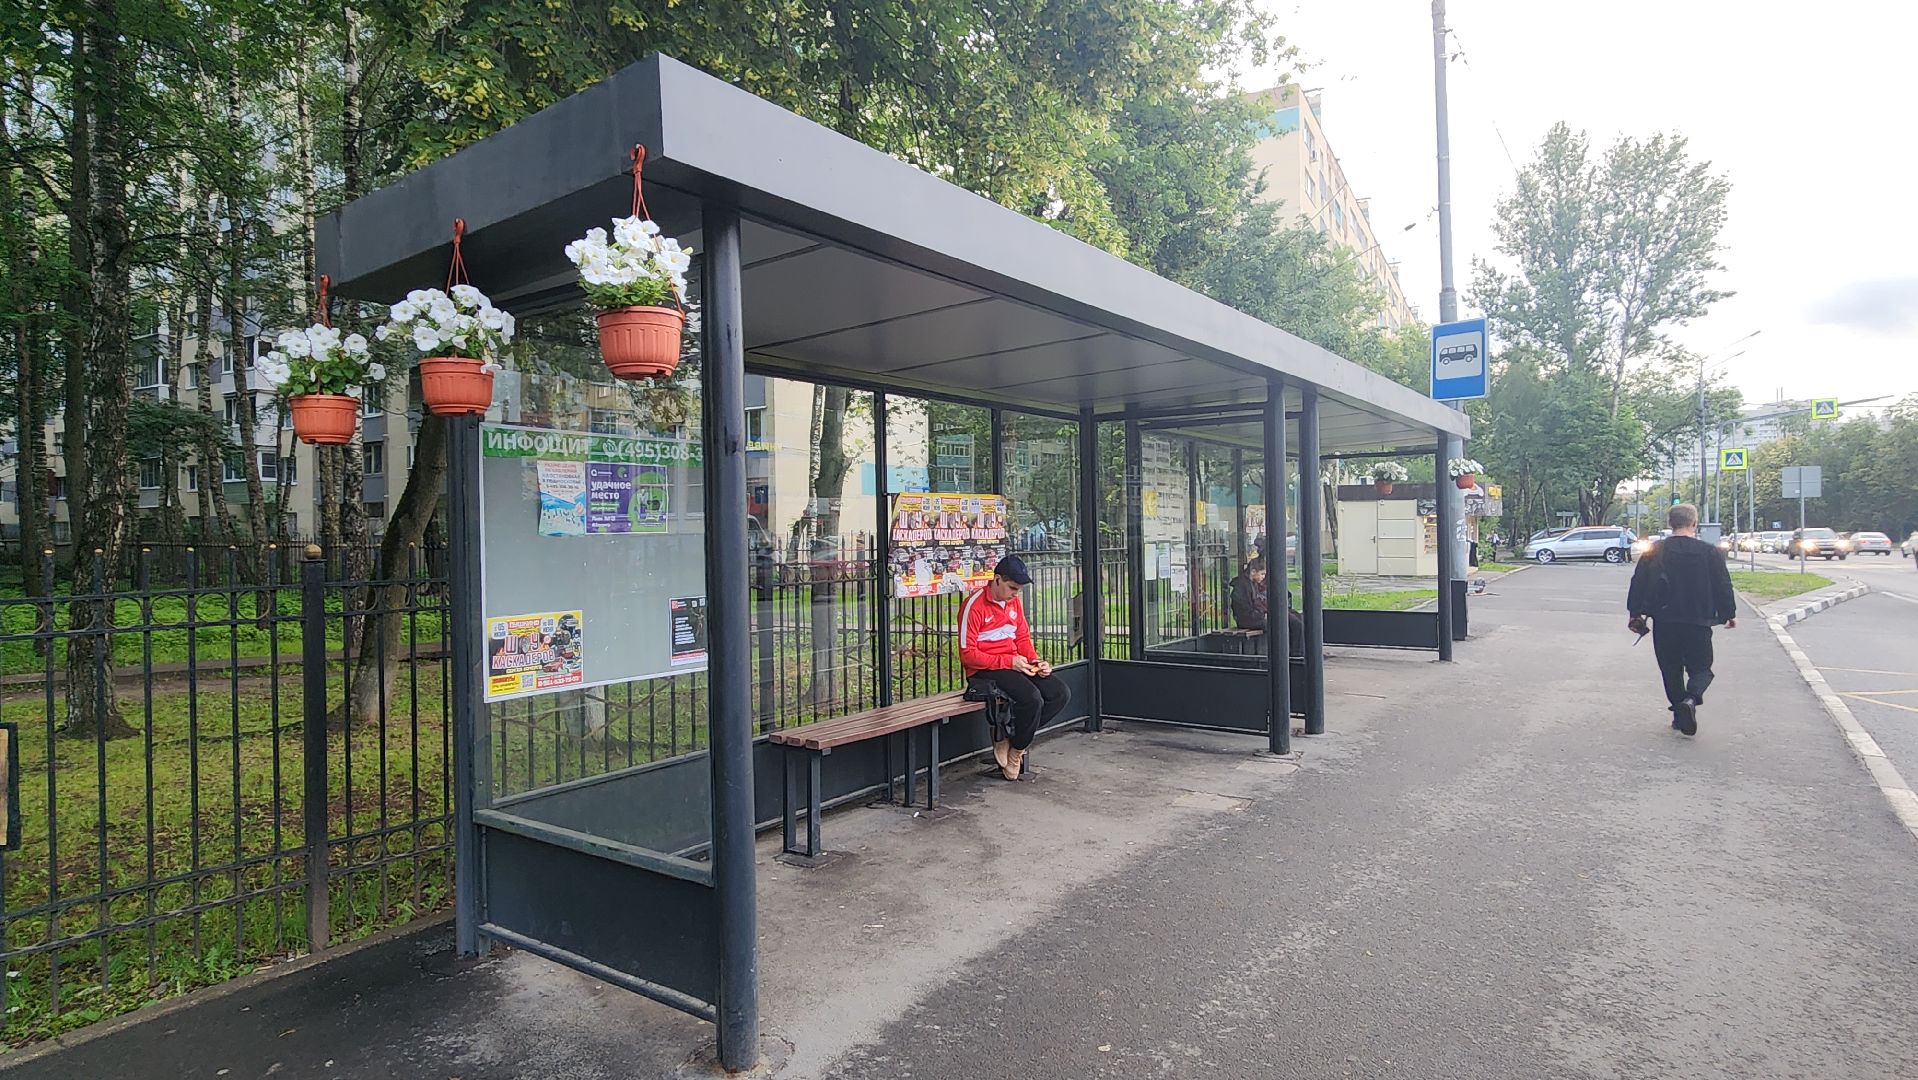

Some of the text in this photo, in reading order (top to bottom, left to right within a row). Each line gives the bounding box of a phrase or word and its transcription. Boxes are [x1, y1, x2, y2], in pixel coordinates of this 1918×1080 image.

[488, 432, 591, 456] ИНФОЩИТ
[591, 481, 632, 491] удачное
[591, 492, 620, 500] место
[492, 648, 556, 669] КАСКАДЕРОВ
